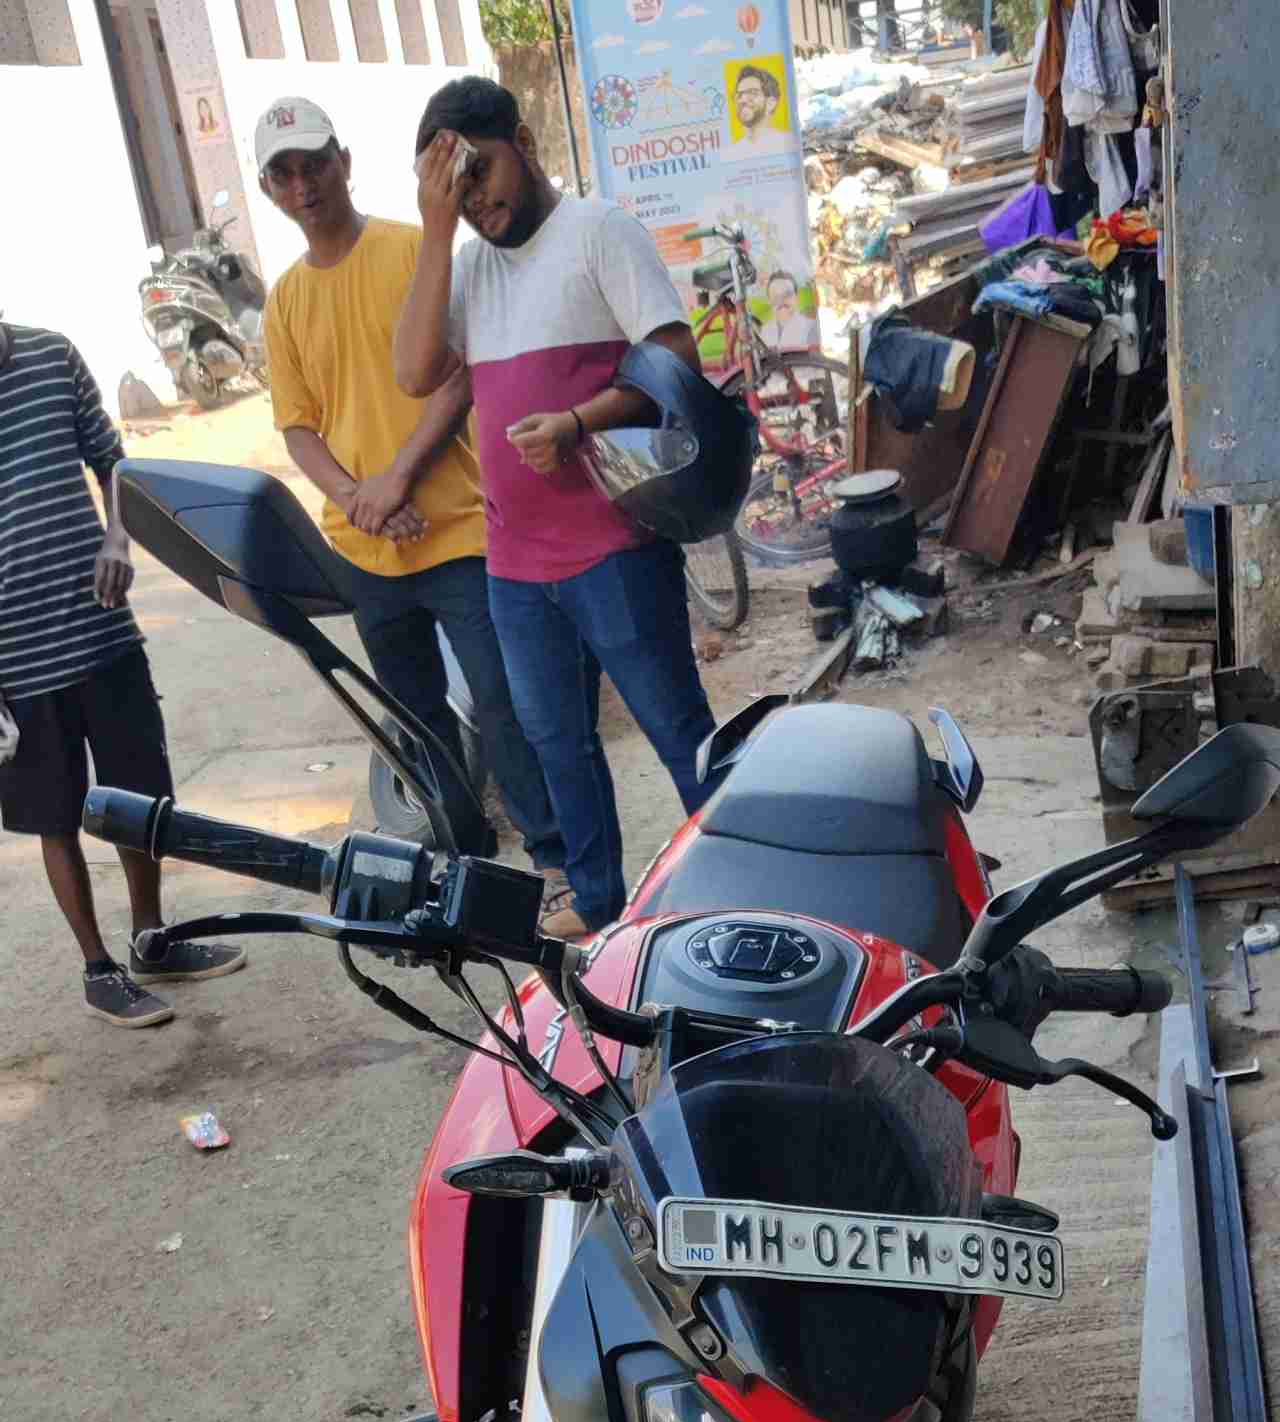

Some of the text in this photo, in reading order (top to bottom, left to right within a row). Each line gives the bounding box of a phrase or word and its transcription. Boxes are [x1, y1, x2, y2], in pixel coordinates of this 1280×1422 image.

[611, 130, 720, 166] DINDOSHI
[628, 154, 711, 182] FESTIVAL
[686, 1247, 714, 1261] IND
[724, 1214, 784, 1264] MH
[813, 1222, 931, 1276] 02FM
[960, 1233, 1056, 1289] 9939
